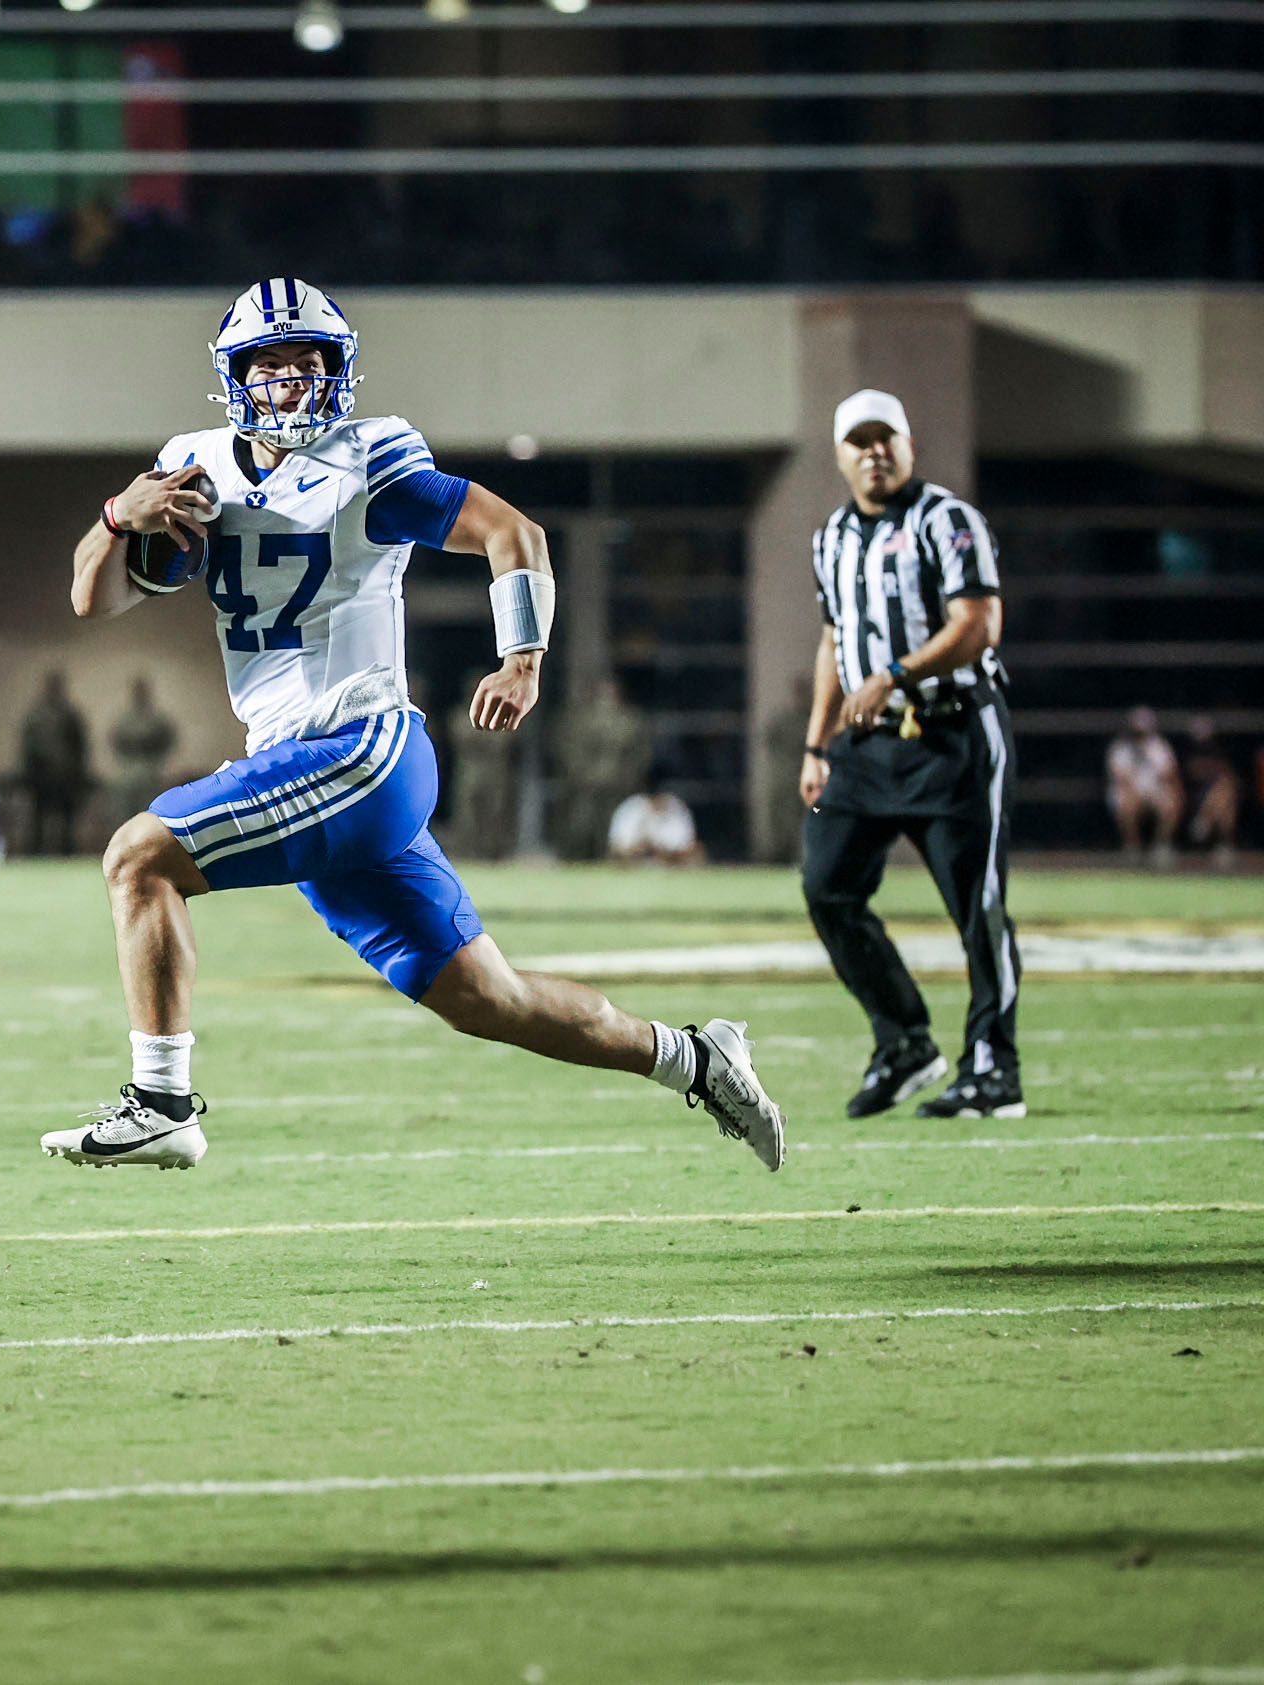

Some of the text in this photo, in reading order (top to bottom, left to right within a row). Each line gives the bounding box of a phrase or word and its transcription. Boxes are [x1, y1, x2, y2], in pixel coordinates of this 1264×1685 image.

[273, 321, 293, 331] BYU
[247, 493, 264, 507] Y
[207, 532, 332, 653] 47
